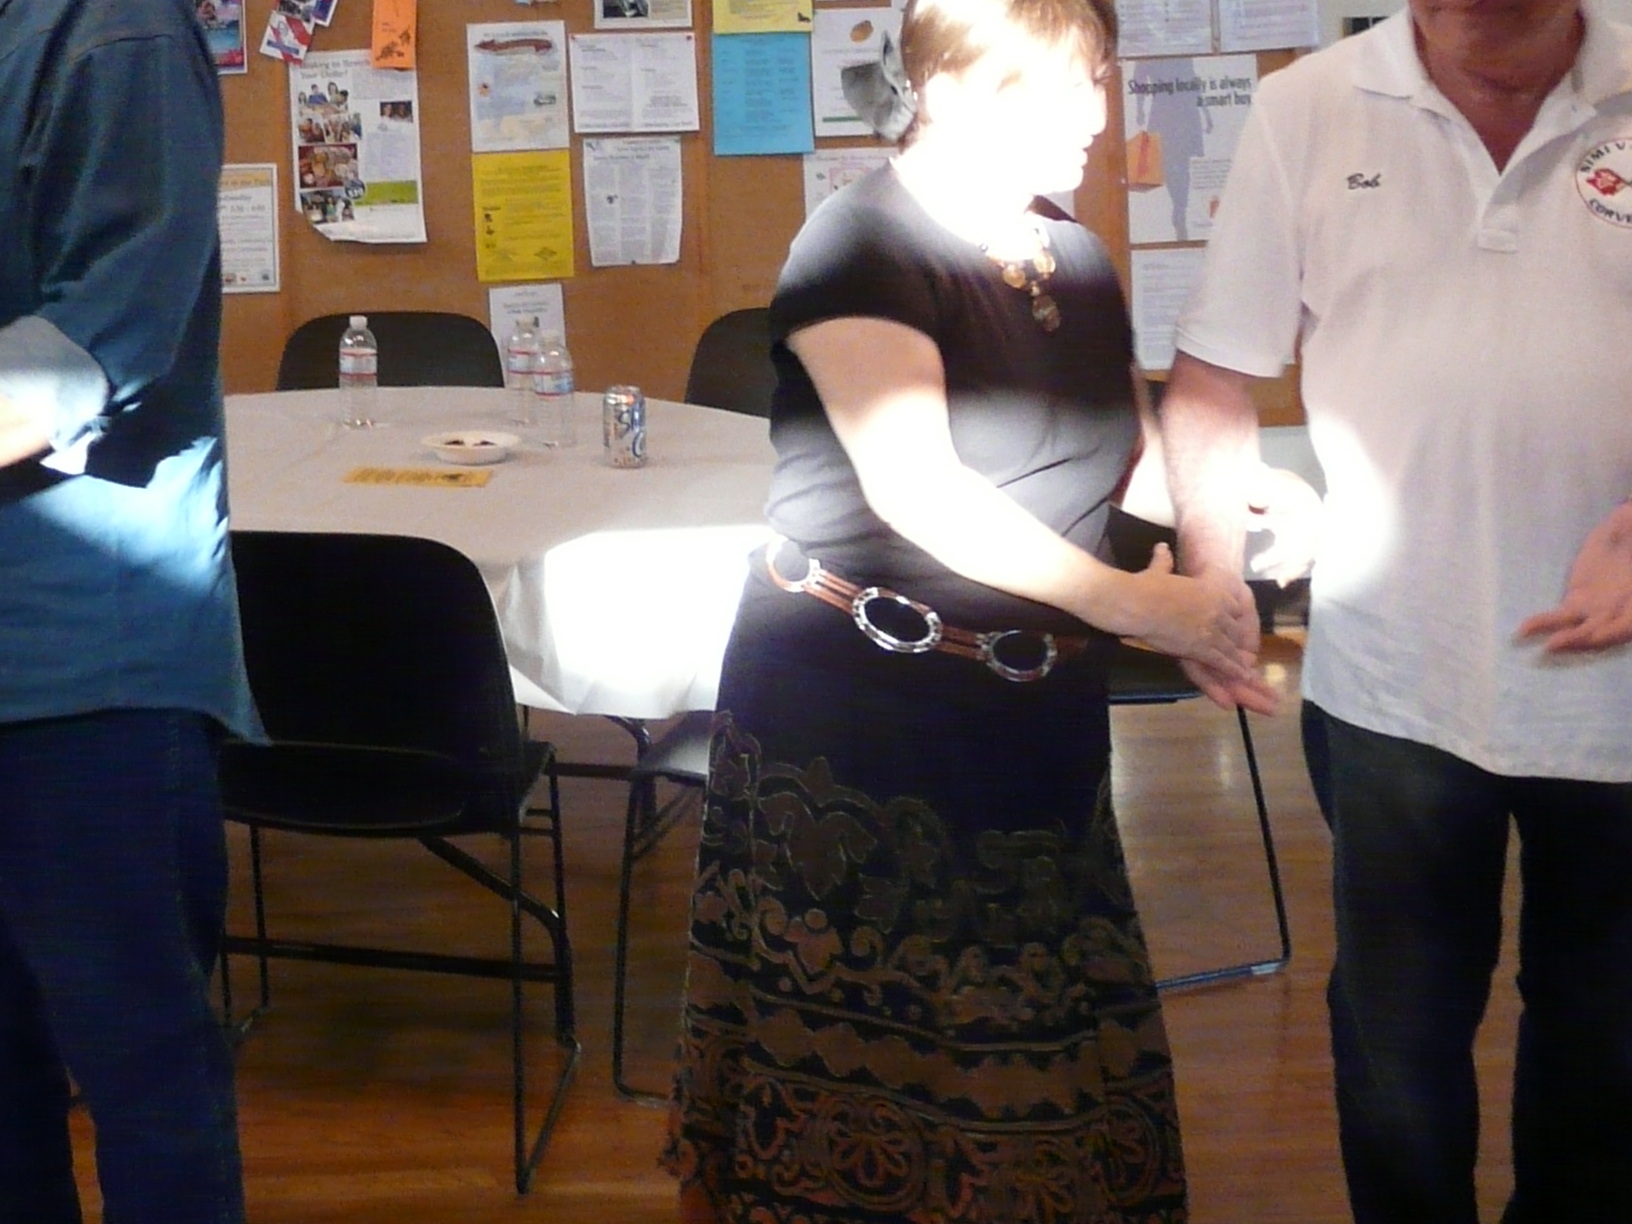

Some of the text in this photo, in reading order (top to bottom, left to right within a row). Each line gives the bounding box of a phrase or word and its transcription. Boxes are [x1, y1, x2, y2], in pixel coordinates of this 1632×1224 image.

[1128, 76, 1251, 96] Shopping locally is always
[1205, 93, 1232, 107] smart
[1234, 91, 1251, 107] buy
[1580, 145, 1610, 173] SIMI
